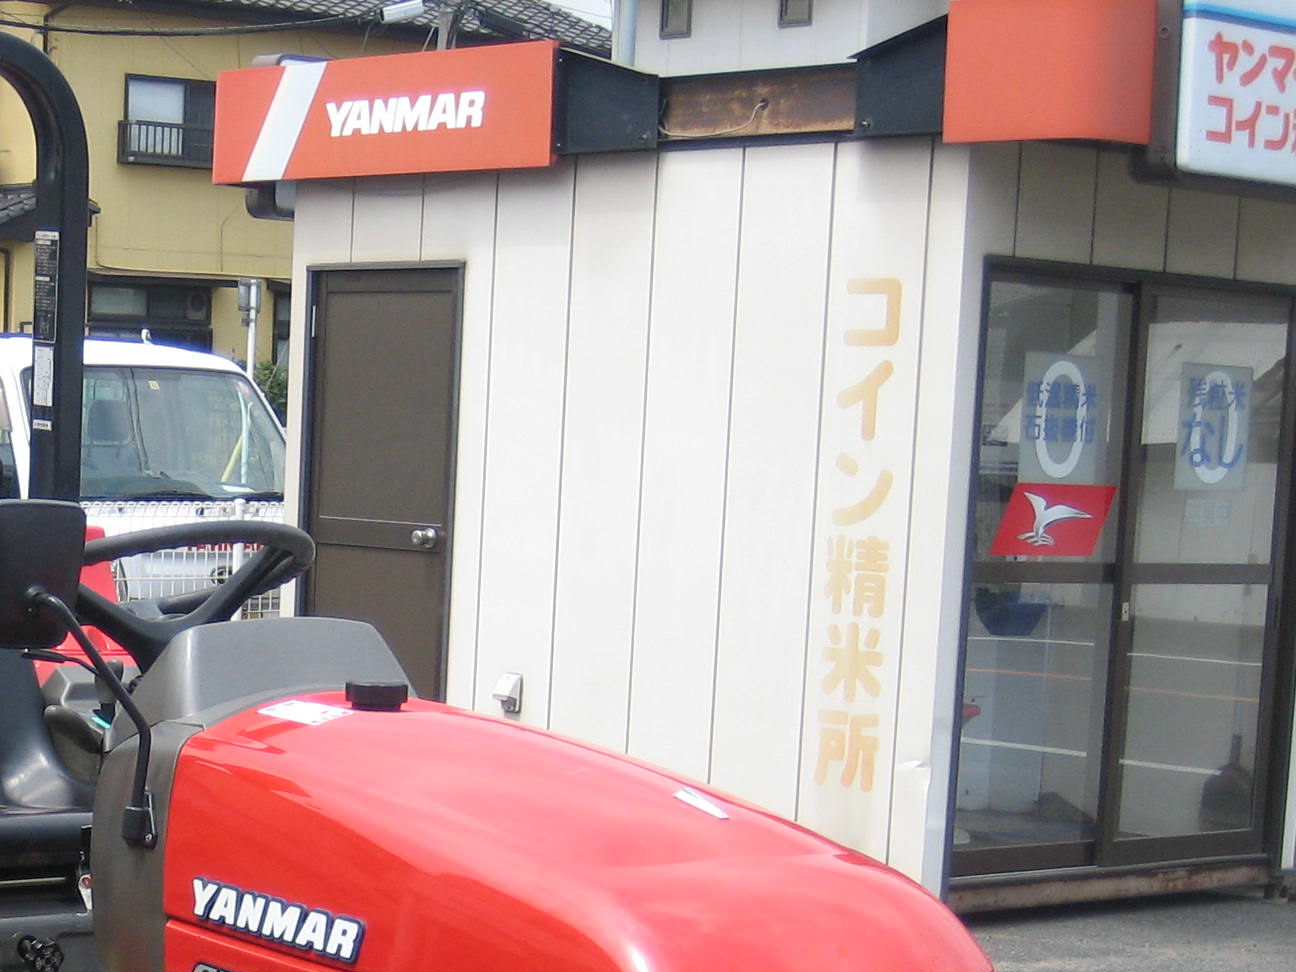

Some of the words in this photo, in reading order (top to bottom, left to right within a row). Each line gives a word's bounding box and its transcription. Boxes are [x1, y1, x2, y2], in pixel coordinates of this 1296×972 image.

[1207, 32, 1296, 94] ヤンマ
[324, 90, 486, 138] YANMAR
[1205, 95, 1296, 155] コイン
[1181, 412, 1244, 469] なし
[814, 278, 903, 792] コイン精米所
[191, 876, 366, 965] YANMAR
